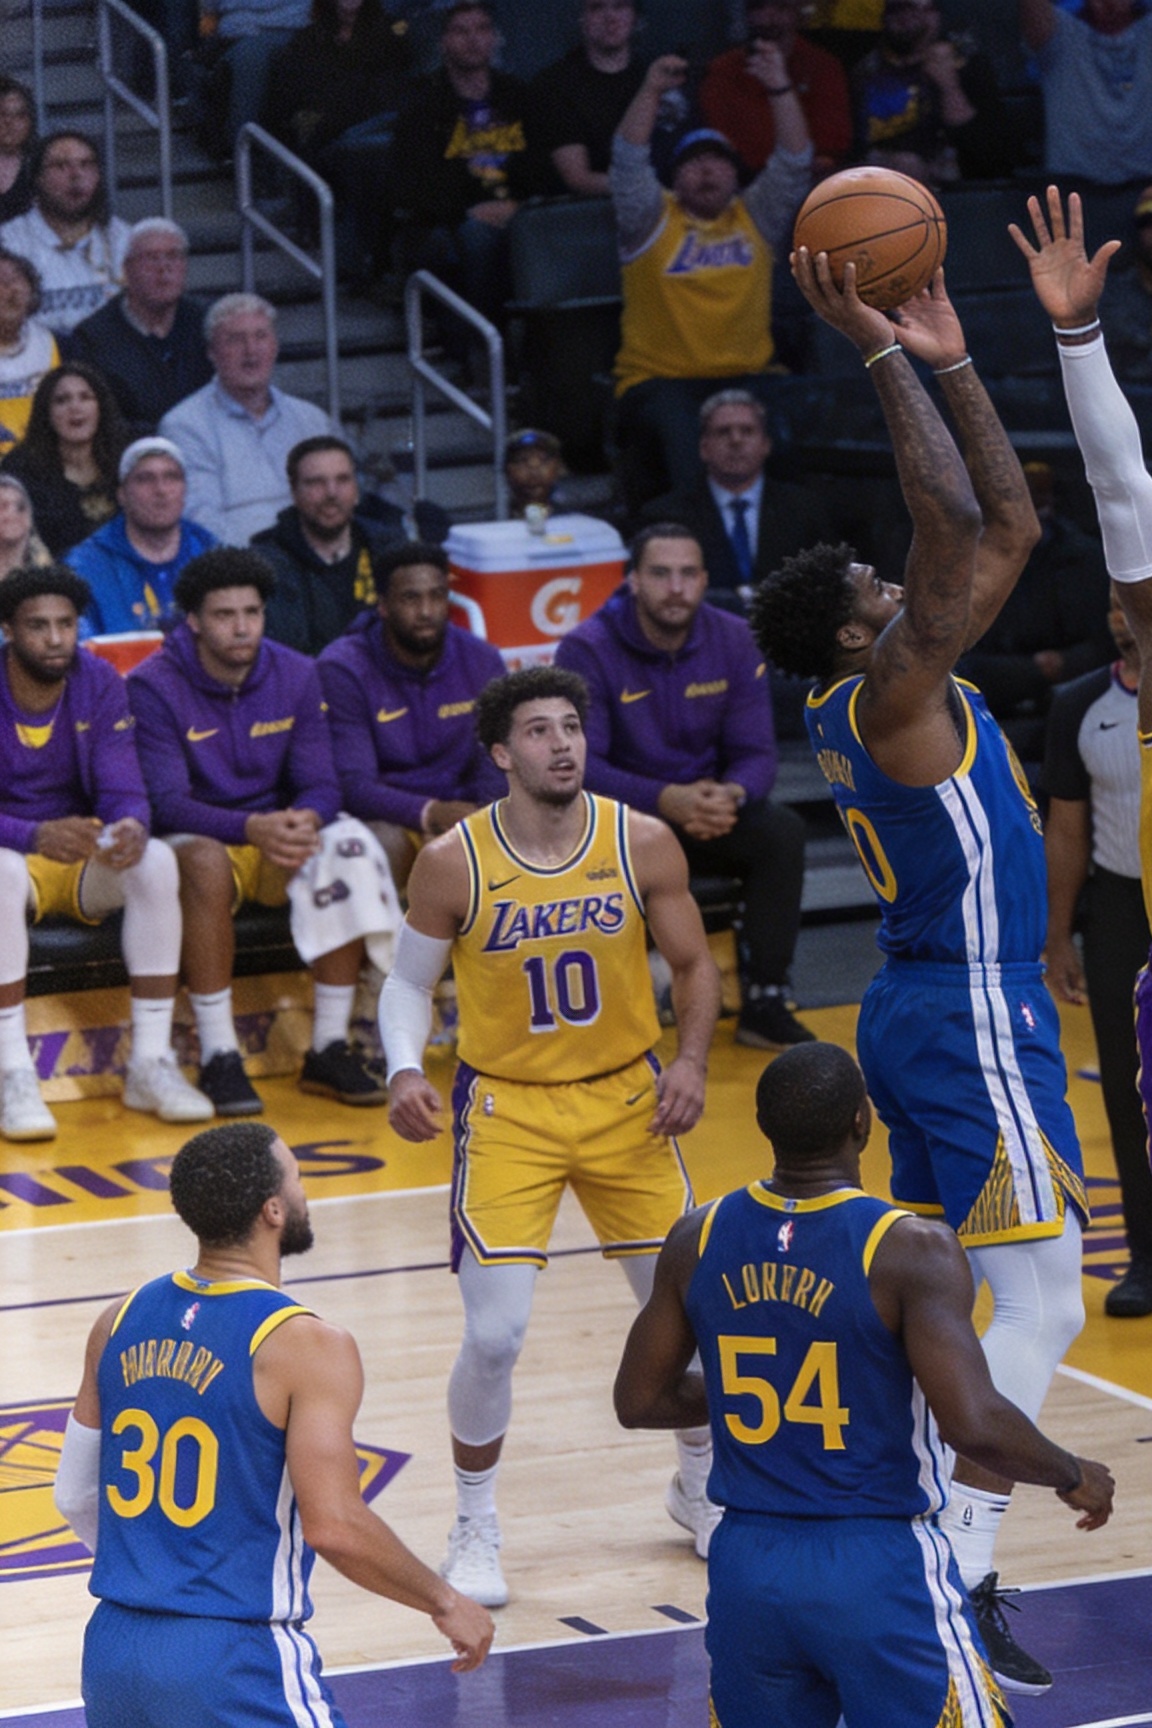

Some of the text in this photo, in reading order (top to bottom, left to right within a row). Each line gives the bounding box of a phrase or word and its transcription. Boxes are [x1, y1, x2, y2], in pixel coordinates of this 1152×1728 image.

[530, 577, 582, 637] G
[477, 892, 625, 954] LAKERS
[522, 949, 602, 1034] 10
[718, 1335, 850, 1450] 54
[106, 1408, 220, 1528] 30
